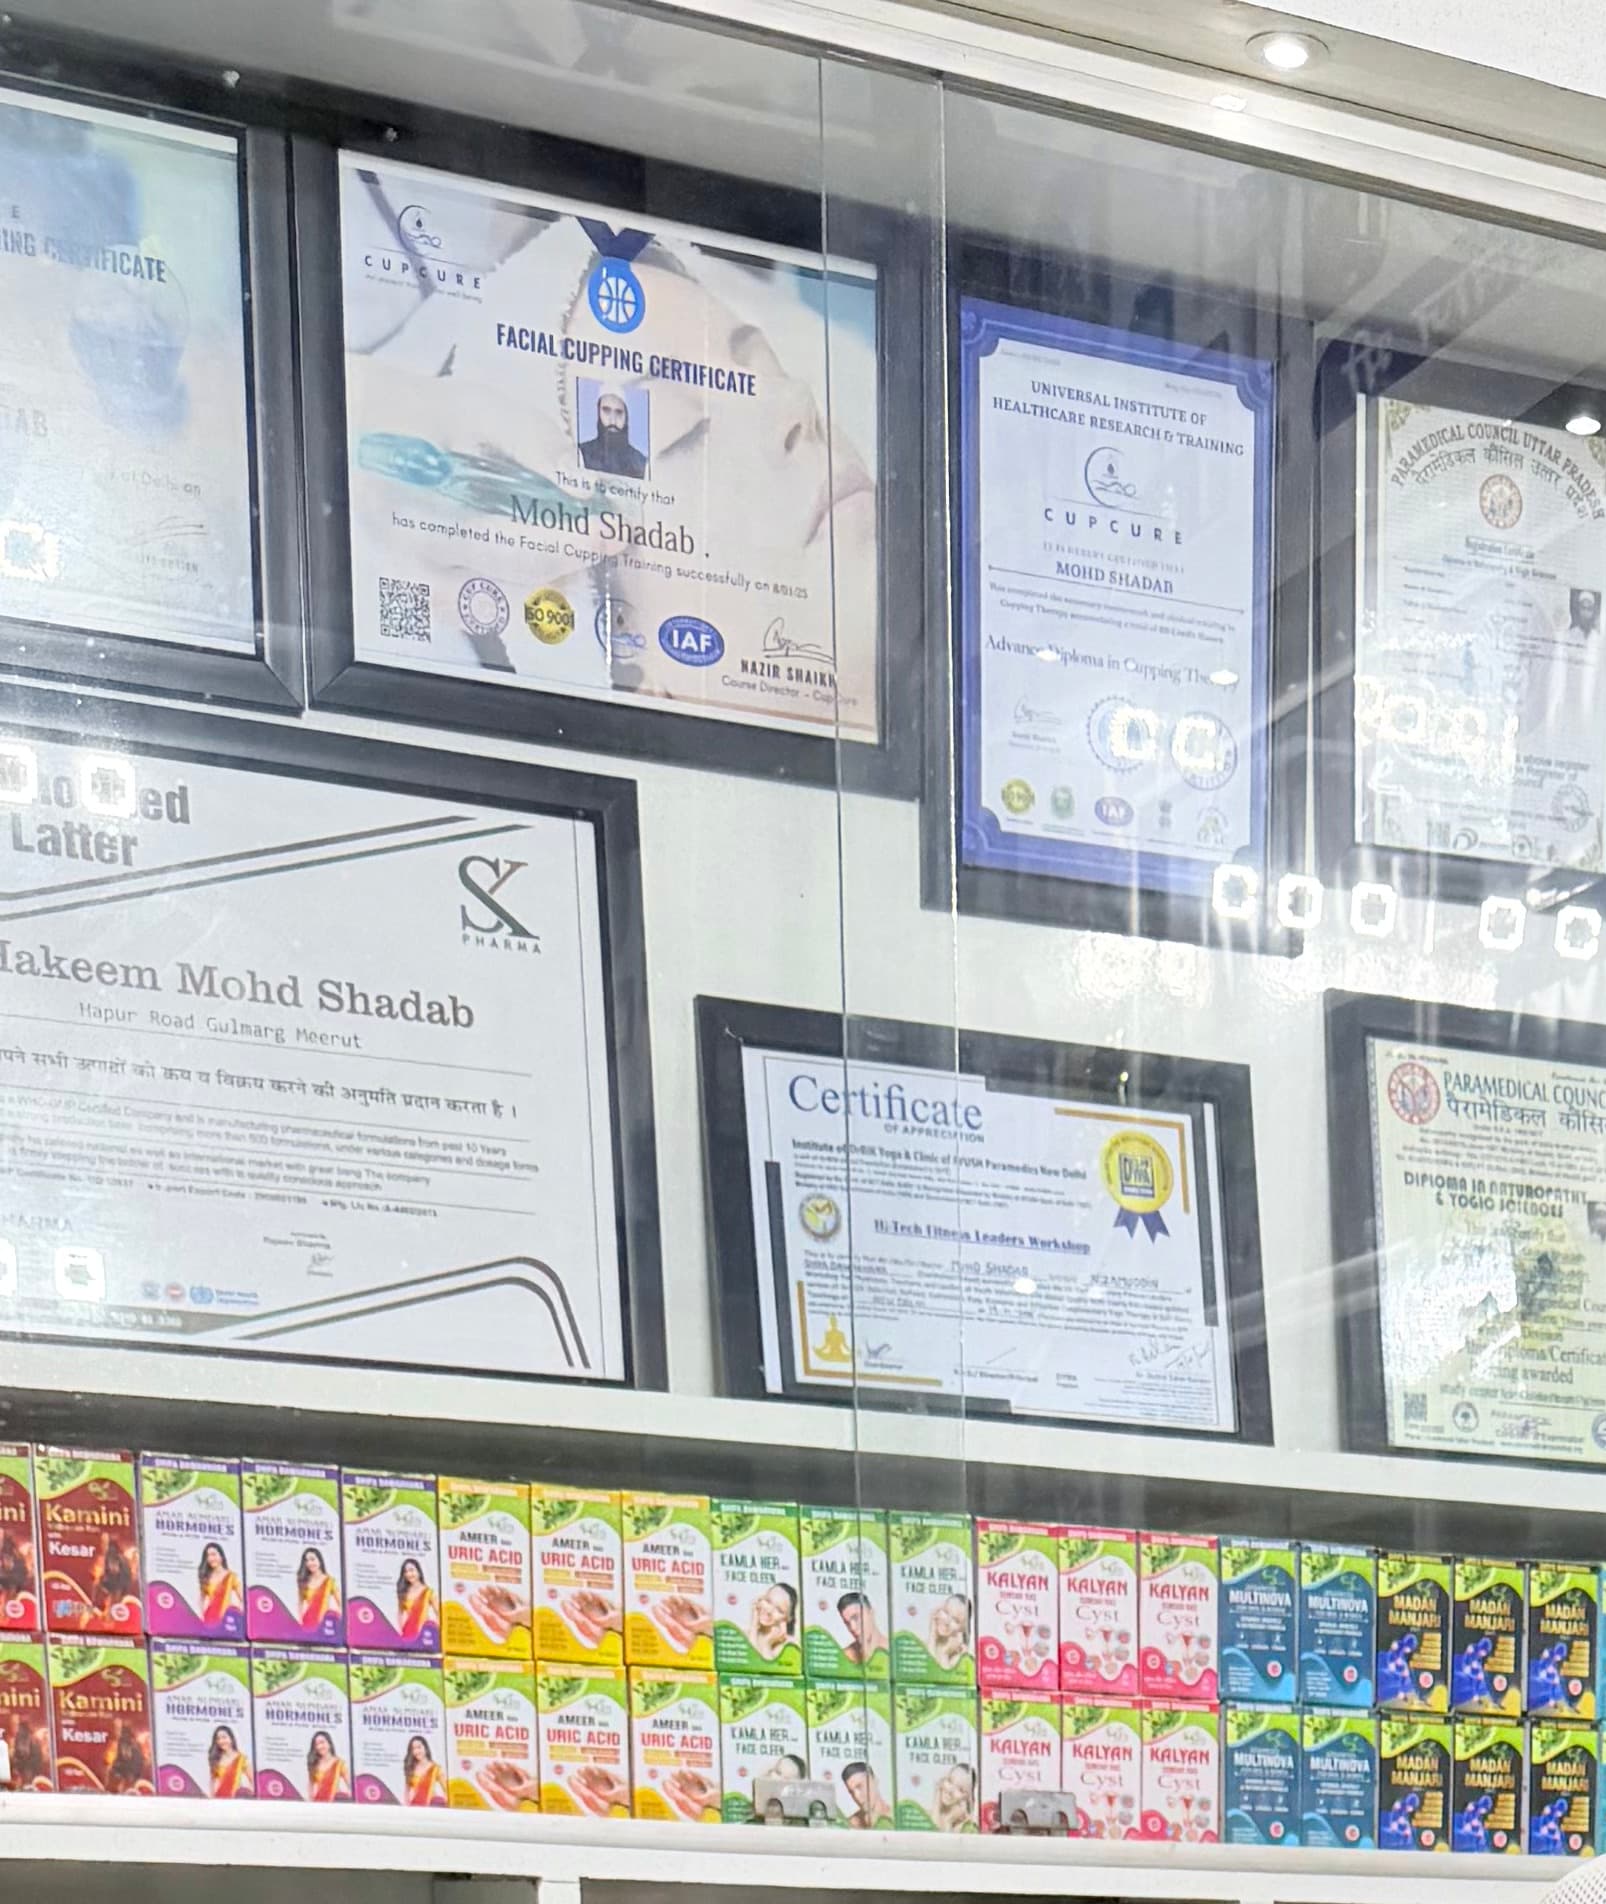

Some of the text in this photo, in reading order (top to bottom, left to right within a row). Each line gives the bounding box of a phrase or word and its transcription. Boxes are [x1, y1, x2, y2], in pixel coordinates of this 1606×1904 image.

[364, 254, 482, 289] CUPCURE
[497, 322, 757, 396] FACIAL CUPPING CERTIFICATE
[1031, 380, 1207, 427] UNIVERSAL INSTITUTE OF
[993, 397, 1245, 457] HEALTHCARE RESEARCH TRAINING
[1391, 424, 1465, 487] PARAMEDICAL
[1467, 422, 1521, 447] COUNCIL
[1523, 431, 1563, 466] UTTAR
[555, 471, 676, 505] This certify that
[510, 494, 696, 555] Mohd Shadab
[1044, 507, 1184, 546] CUPCURE
[391, 512, 416, 530] has
[419, 519, 490, 545] completed
[494, 532, 516, 548] the
[519, 535, 560, 555] Facial
[622, 552, 673, 578] Training
[676, 564, 752, 592] successfully
[1056, 561, 1174, 595] MOHD SHADAB
[672, 628, 713, 655] IAF
[740, 660, 781, 680] NAZIR
[11, 812, 139, 867] Latter
[462, 932, 542, 955] PHARMA
[176, 961, 303, 1009] Mohd
[317, 978, 475, 1030] Shadab
[79, 1002, 363, 1050] Hapur Road Gulmarg Meerut
[789, 1074, 983, 1132] Certificate
[1443, 1071, 1549, 1104] PARAMEDICAL
[45, 1502, 130, 1528] Kamini
[155, 1518, 235, 1537] HORMONES
[48, 1538, 95, 1559] Kesar
[448, 1545, 523, 1566] URIC ACID
[986, 1571, 1049, 1591] KALYAN
[1228, 1588, 1292, 1606] MULTINOVA
[1393, 1594, 1437, 1611] MADAN
